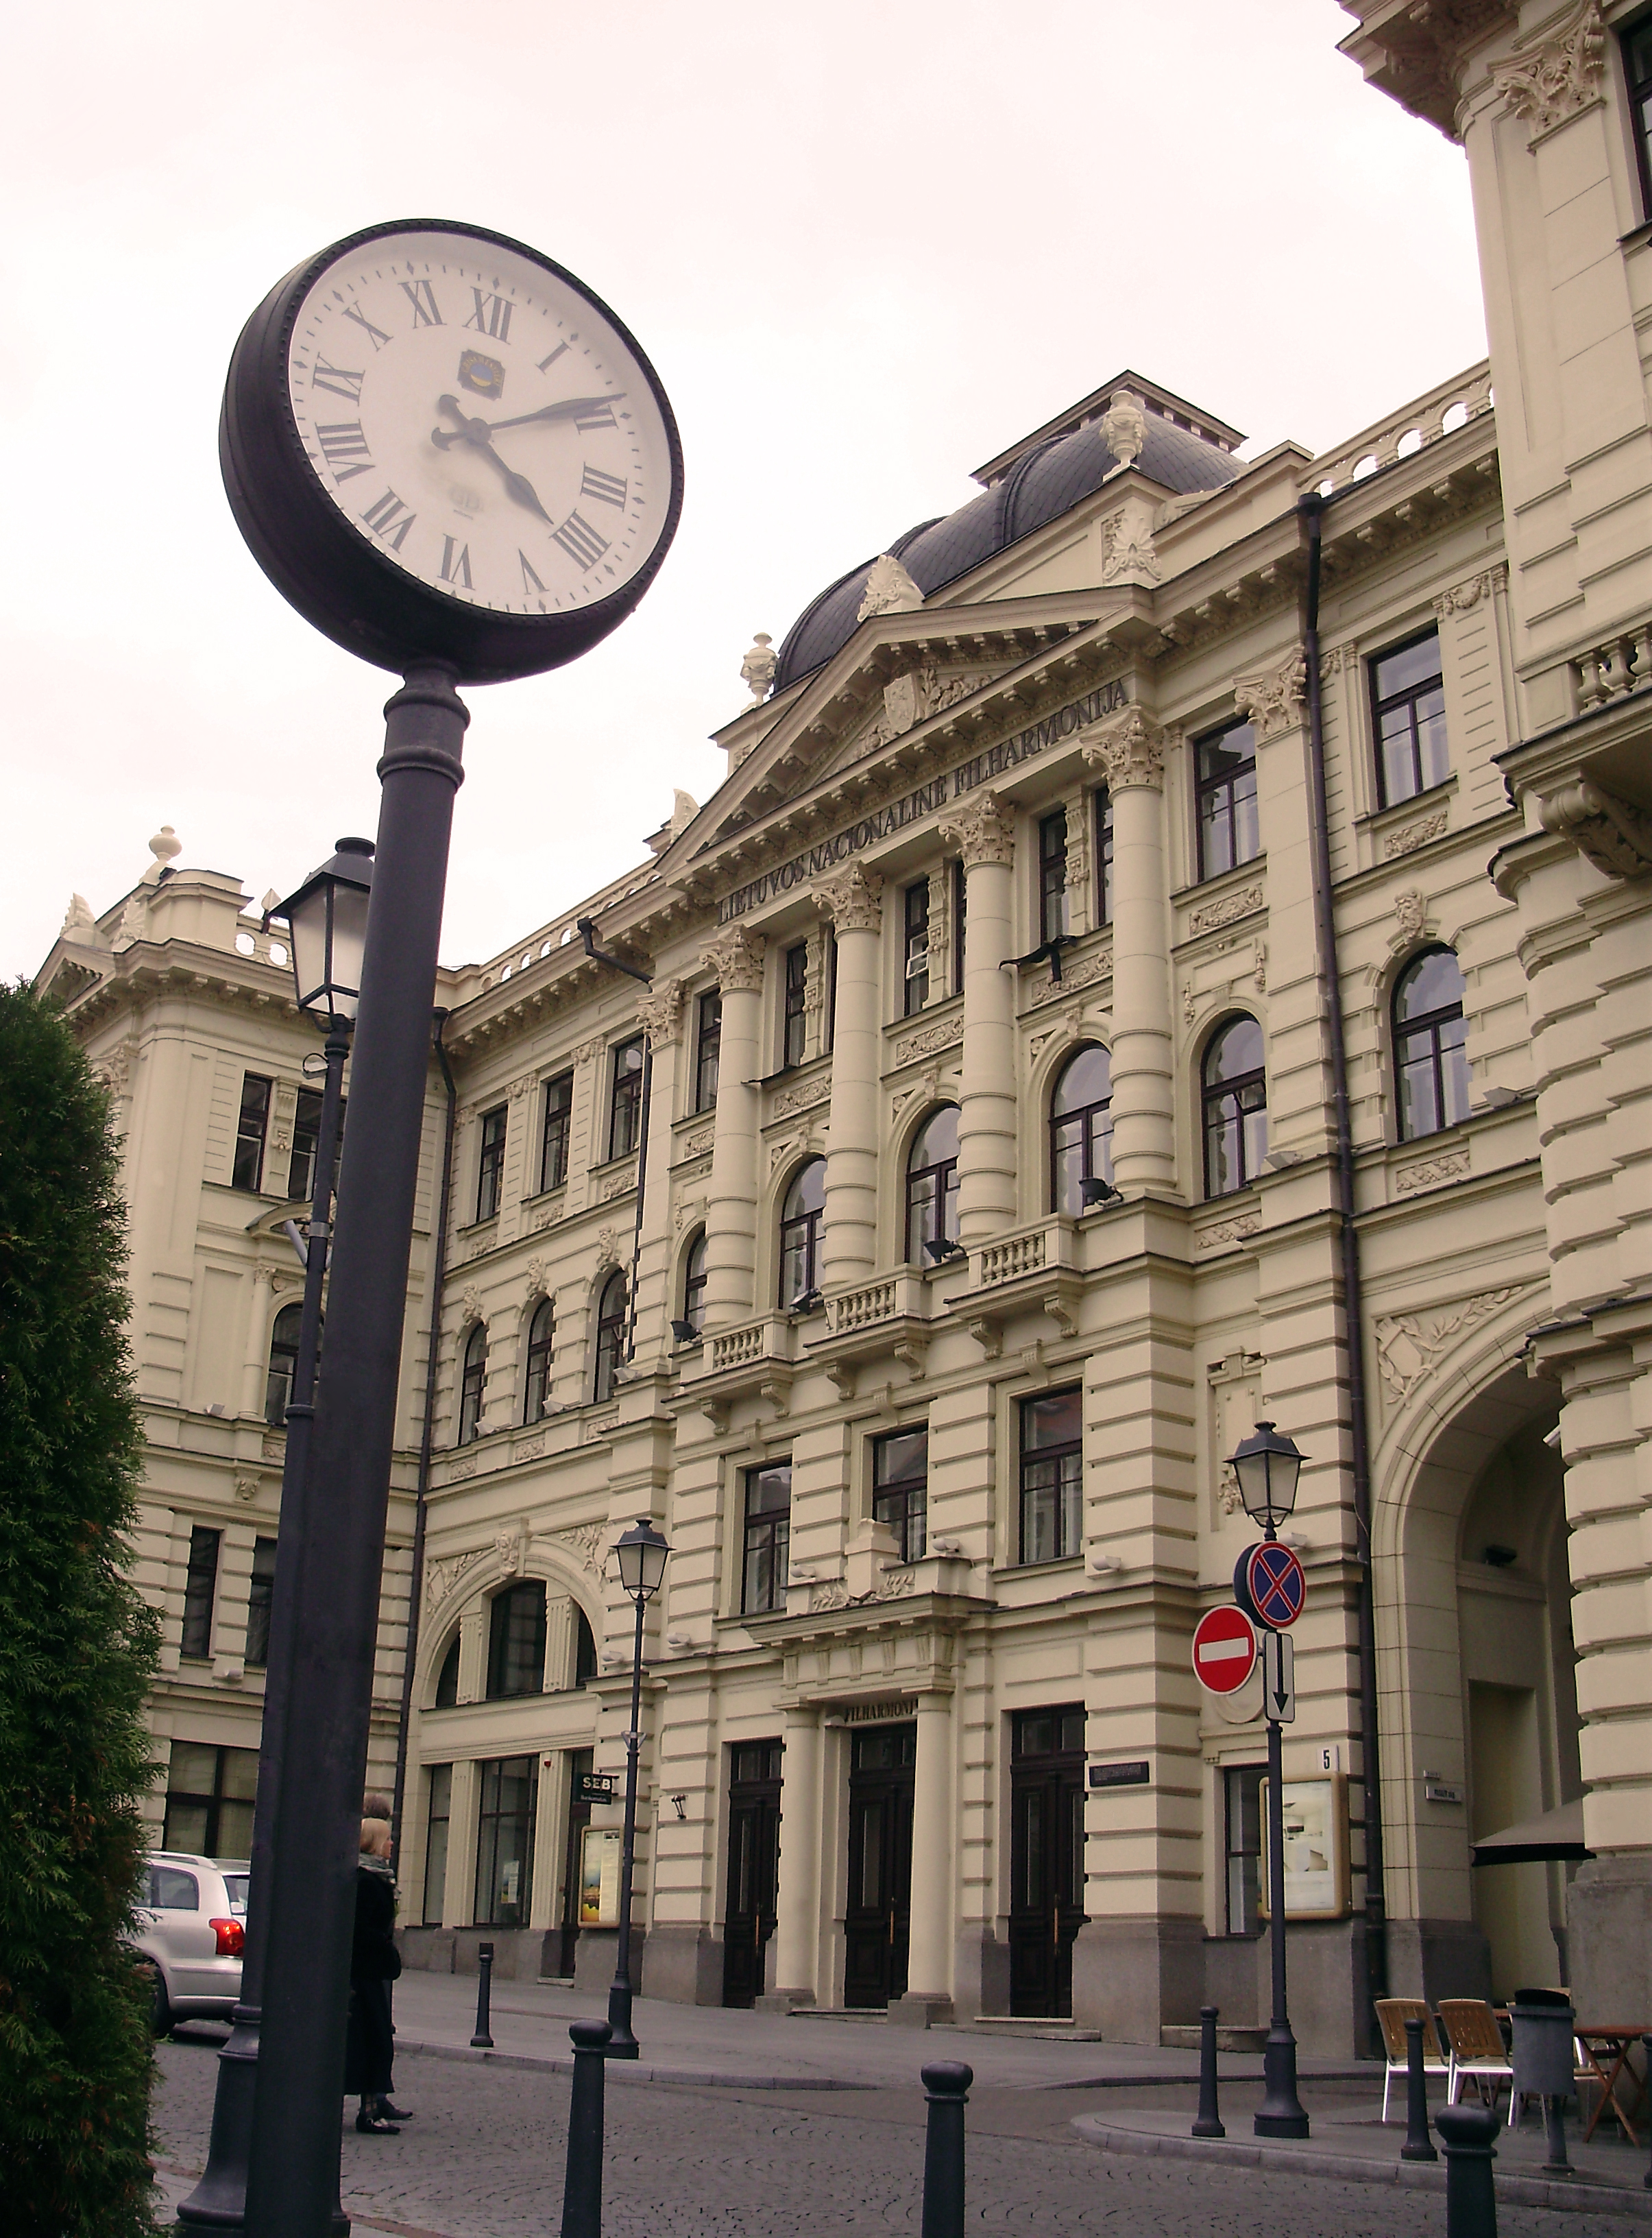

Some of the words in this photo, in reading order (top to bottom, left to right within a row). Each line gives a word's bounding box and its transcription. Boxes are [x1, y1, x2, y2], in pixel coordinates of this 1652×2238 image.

[343, 300, 393, 351] X
[398, 280, 447, 329] XI
[463, 286, 516, 344] XII
[312, 351, 365, 406] IX
[536, 339, 577, 374] I
[315, 418, 375, 485] VIII
[581, 461, 629, 512] III
[360, 487, 417, 553] VII
[549, 509, 613, 573] IIII
[438, 533, 476, 591] VI
[518, 549, 549, 596] V
[718, 854, 804, 926] LIETUVOS
[953, 679, 1128, 798] FILHARMONIJA
[583, 1777, 611, 1790] SEB
[1323, 1749, 1330, 1770] 5
